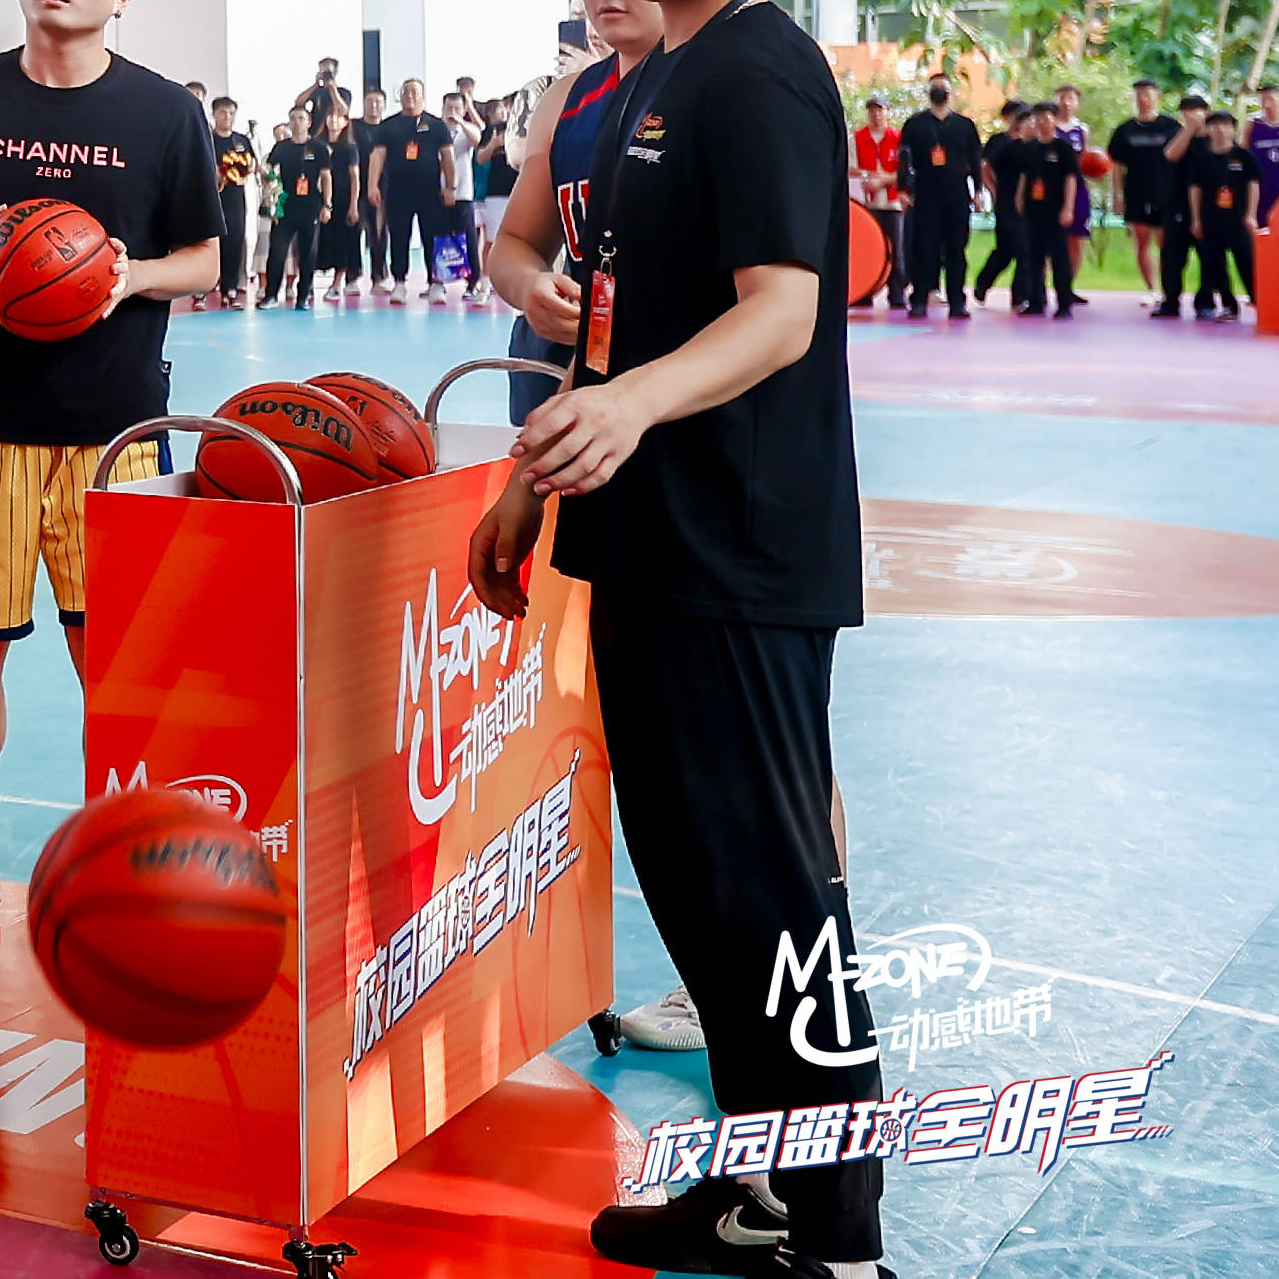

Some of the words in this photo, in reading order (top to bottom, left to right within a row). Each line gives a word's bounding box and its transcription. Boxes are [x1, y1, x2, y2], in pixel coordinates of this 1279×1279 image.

[35, 166, 73, 179] ZERO
[238, 399, 354, 452] Wilson
[449, 622, 547, 813] 动感地带
[343, 748, 582, 1081] 校园篮球全明星
